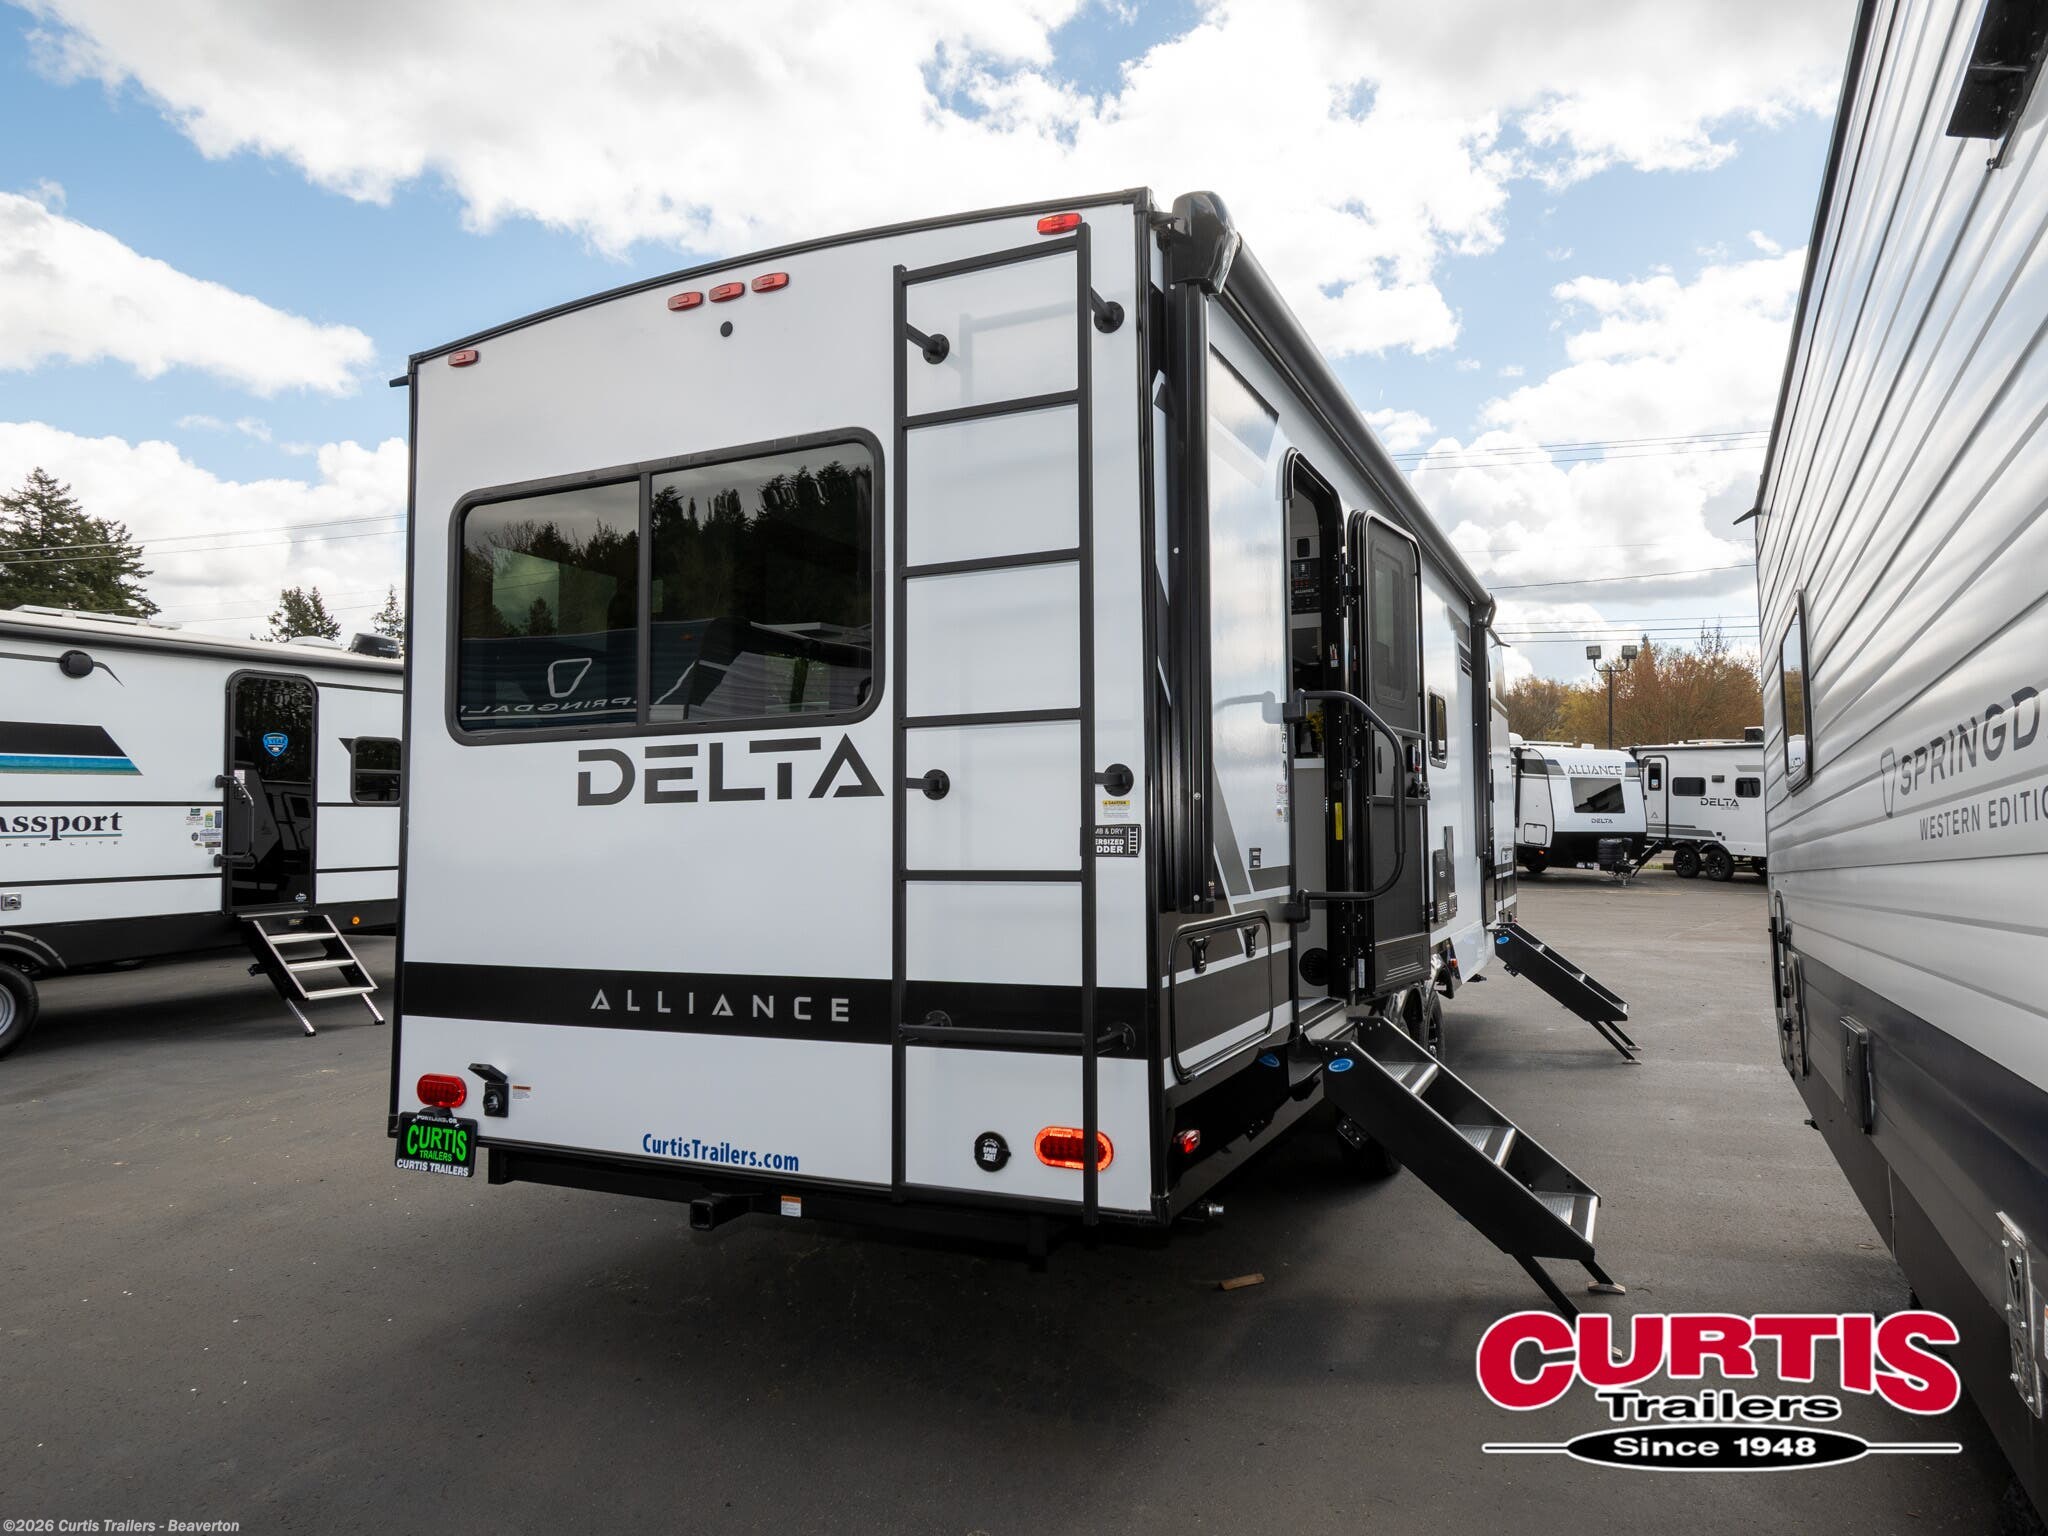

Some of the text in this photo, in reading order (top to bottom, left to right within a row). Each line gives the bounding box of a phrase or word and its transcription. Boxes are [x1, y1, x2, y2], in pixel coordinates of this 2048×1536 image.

[577, 732, 886, 807] DELTA
[1568, 764, 1623, 776] ALLIANCE
[1700, 797, 1740, 807] DELTA
[1919, 803, 1981, 841] WESTERN
[1096, 845, 1124, 854] DDER
[590, 988, 850, 1023] ALLIANCE
[406, 1124, 468, 1162] CURTIS
[419, 1149, 453, 1162] TRAILERS
[642, 1133, 800, 1172] CurtisTrailers.com
[396, 1158, 469, 1177] CURTIS TRAILERS
